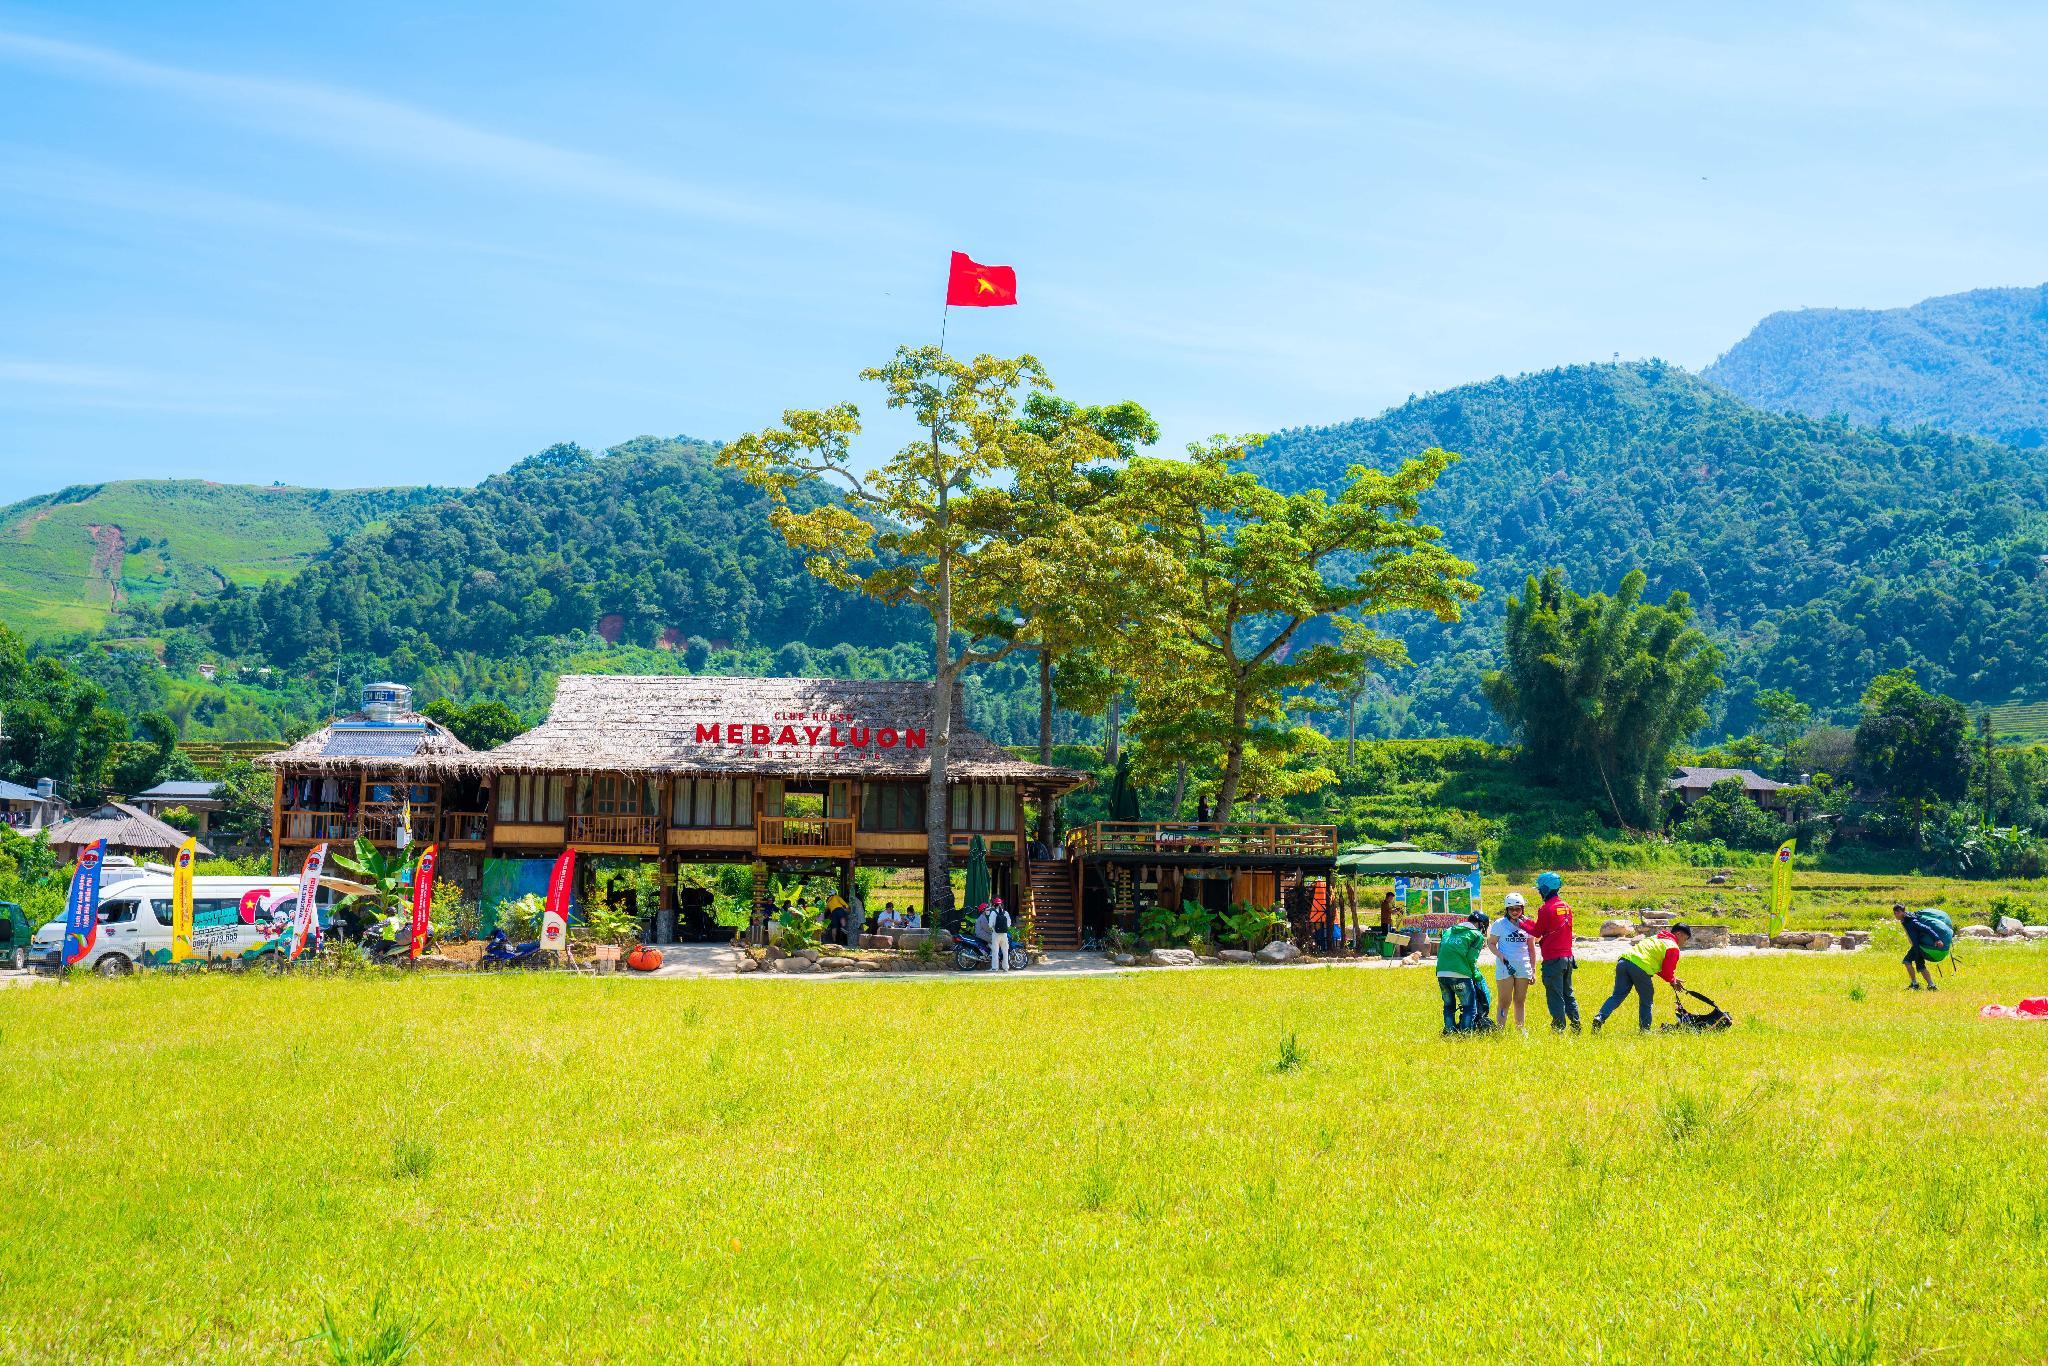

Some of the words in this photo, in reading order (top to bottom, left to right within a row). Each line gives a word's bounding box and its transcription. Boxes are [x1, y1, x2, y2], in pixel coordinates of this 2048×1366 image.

[774, 711, 805, 721] CLUB
[812, 712, 854, 723] HOUSE
[695, 723, 927, 749] MEBAYLUON
